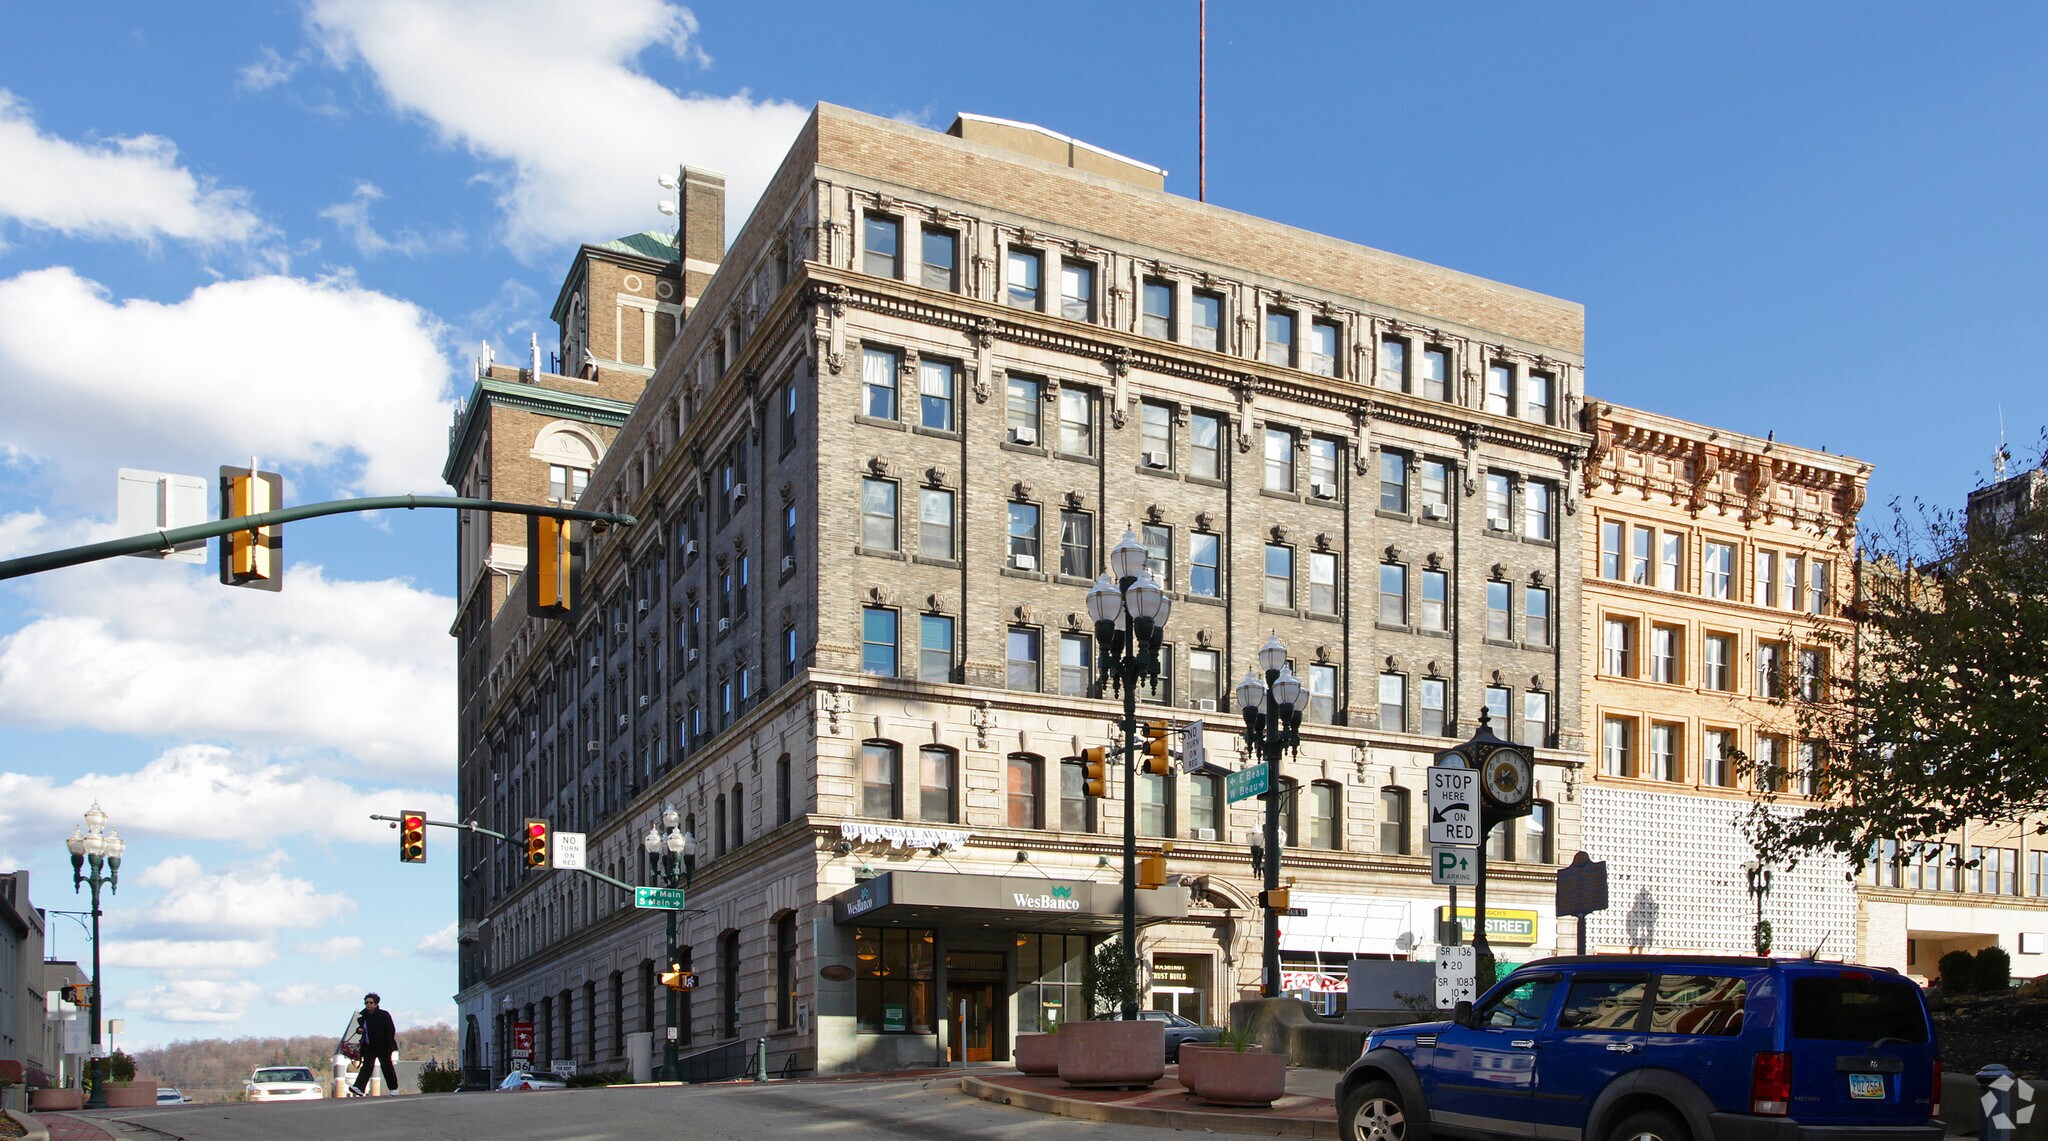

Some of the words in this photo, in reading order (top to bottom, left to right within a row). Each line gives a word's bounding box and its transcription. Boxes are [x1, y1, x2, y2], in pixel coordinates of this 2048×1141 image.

[1188, 726, 1197, 739] NO
[1186, 738, 1200, 749] TURN
[1189, 750, 1197, 759] ON
[1188, 759, 1199, 769] RED
[1240, 773, 1244, 783] E
[1246, 767, 1265, 781] Beau
[1435, 774, 1472, 789] STOP
[1230, 789, 1236, 799] W
[1239, 783, 1258, 796] Beau
[1442, 791, 1465, 801] HERE
[1454, 812, 1466, 822] ON
[842, 824, 880, 836] OFFICE
[884, 827, 918, 839] SPACE
[1446, 824, 1474, 839] RED
[563, 837, 576, 845] NO
[639, 897, 646, 905] S
[648, 898, 670, 906] Main
[846, 898, 873, 915] WesBanco
[1013, 893, 1080, 910] WesBanco
[1457, 917, 1476, 931] AIN
[1485, 919, 1531, 933] STREET
[1440, 947, 1451, 956] SR
[1458, 948, 1472, 956] 136
[1451, 962, 1463, 970] 20
[1152, 972, 1169, 980] TRUST
[1438, 978, 1449, 986] SR
[1456, 978, 1475, 987] 1083
[1451, 989, 1460, 997] 10
[512, 1061, 529, 1071] 136
